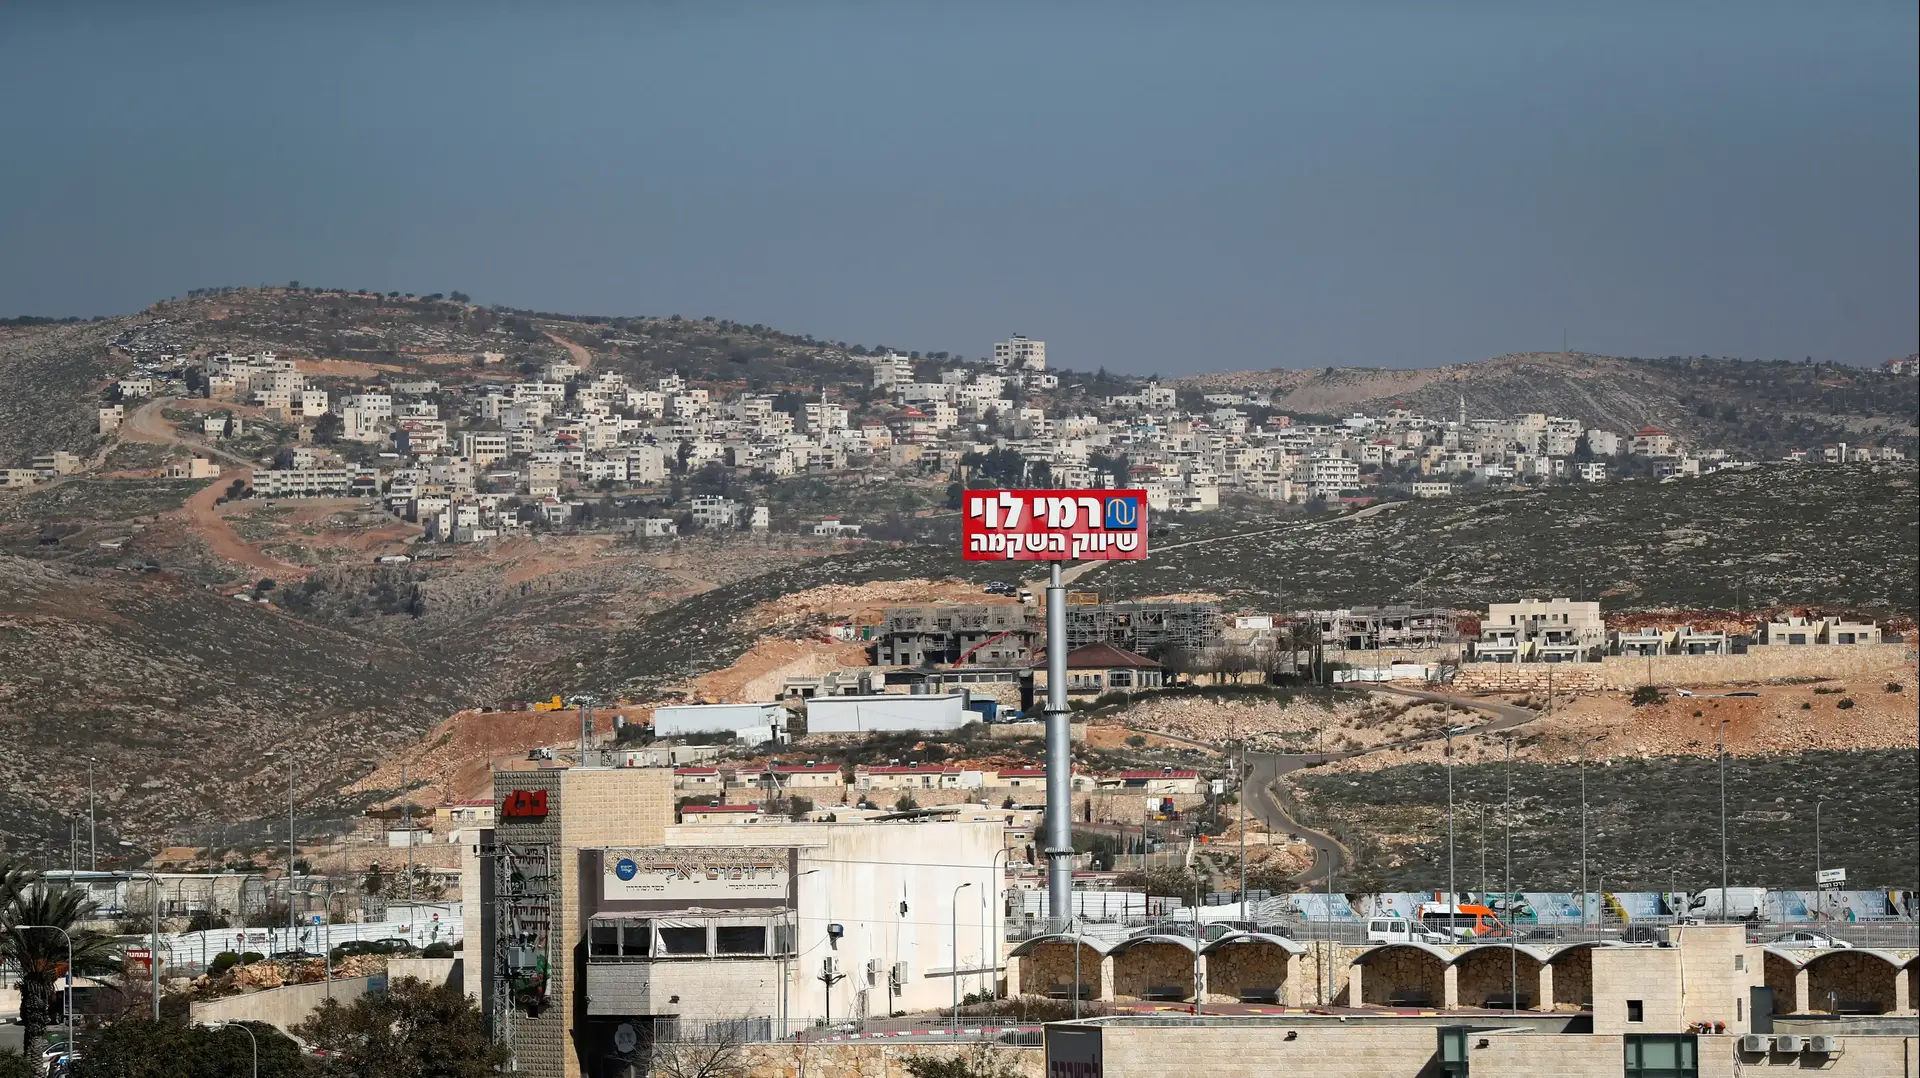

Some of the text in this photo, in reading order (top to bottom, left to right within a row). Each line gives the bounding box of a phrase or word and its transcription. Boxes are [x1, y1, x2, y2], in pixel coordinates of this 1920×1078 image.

[971, 491, 1101, 528] רמי לוי
[971, 533, 1138, 559] שיווק השקמה
